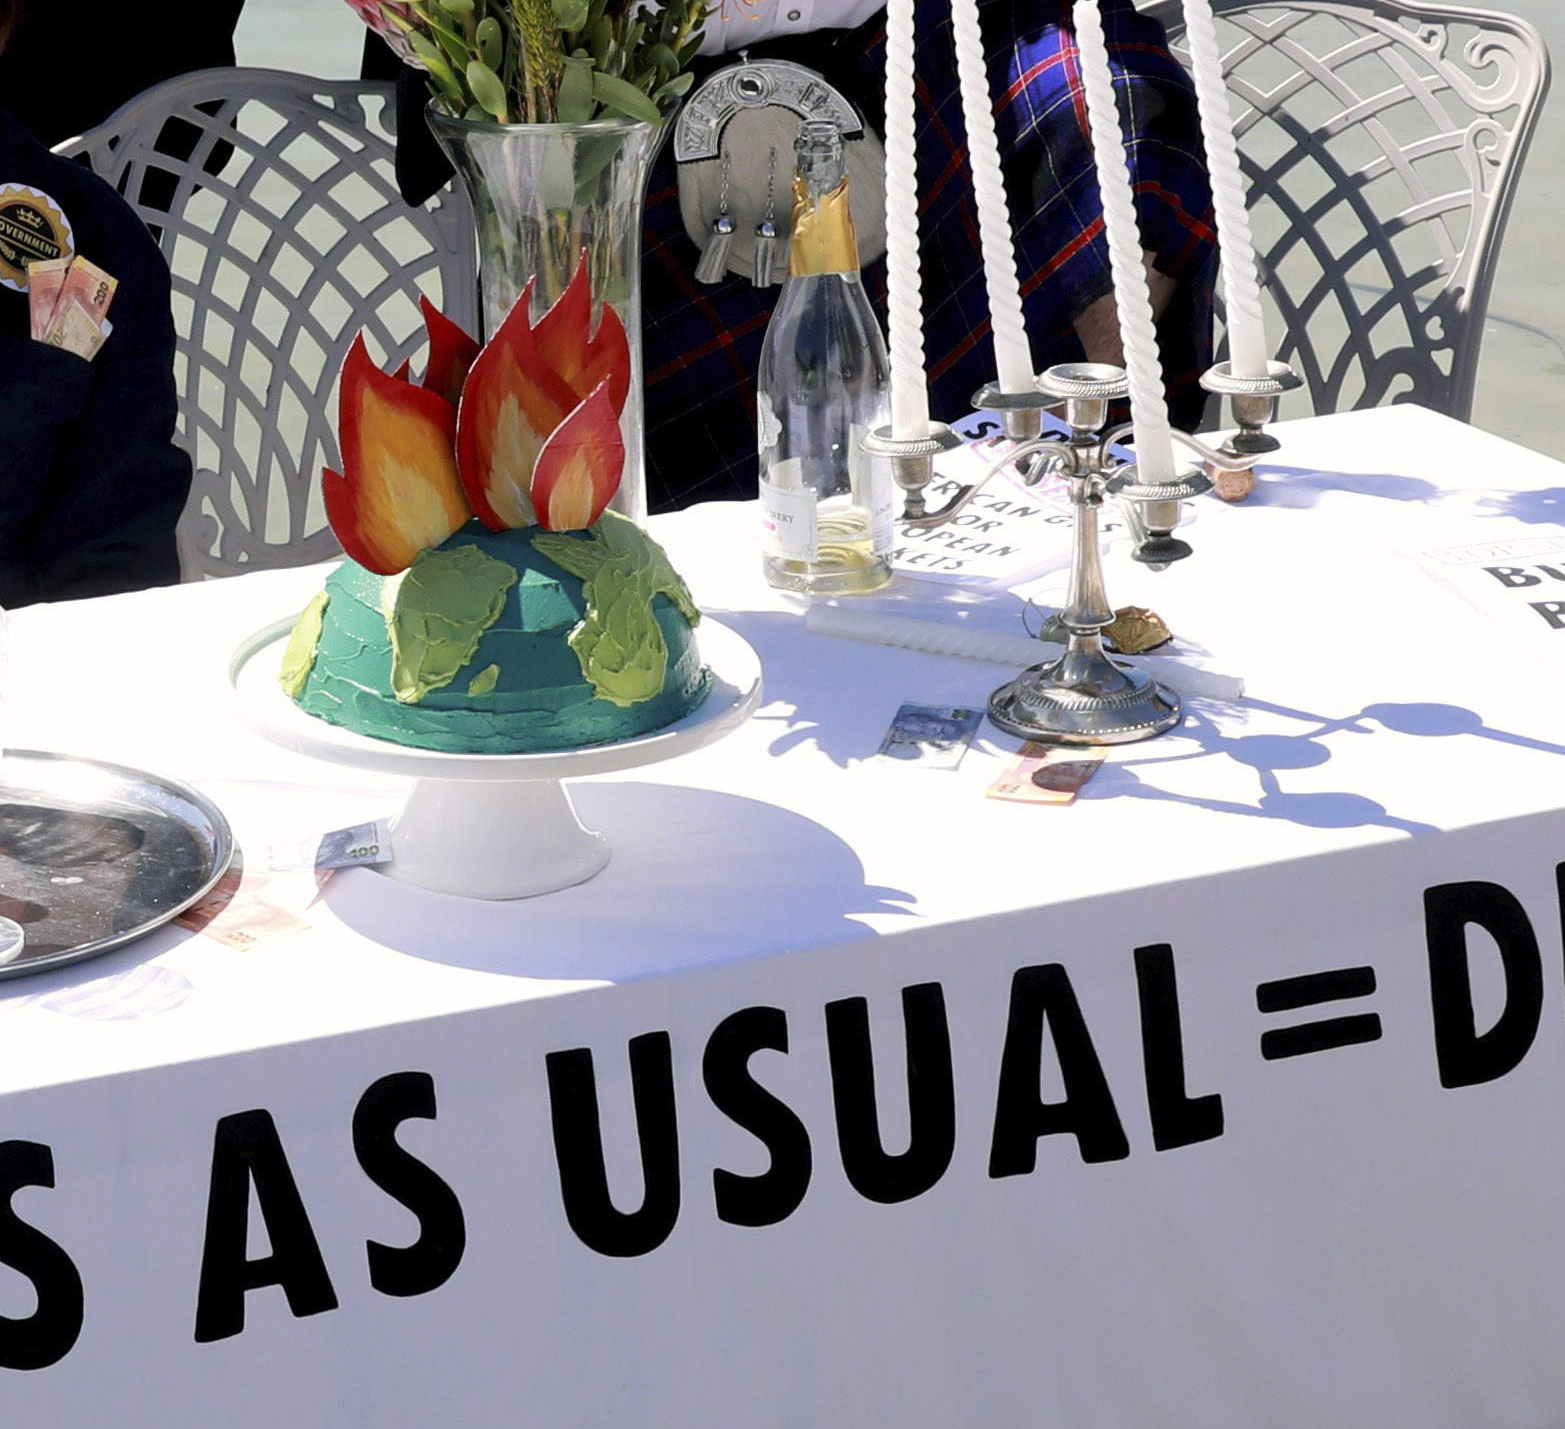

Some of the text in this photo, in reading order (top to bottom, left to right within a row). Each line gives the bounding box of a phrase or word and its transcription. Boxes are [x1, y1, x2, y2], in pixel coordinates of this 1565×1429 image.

[93, 281, 110, 307] 200
[951, 515, 1004, 532] OR
[194, 1071, 466, 1343] AS
[545, 943, 1224, 1258] USUAL
